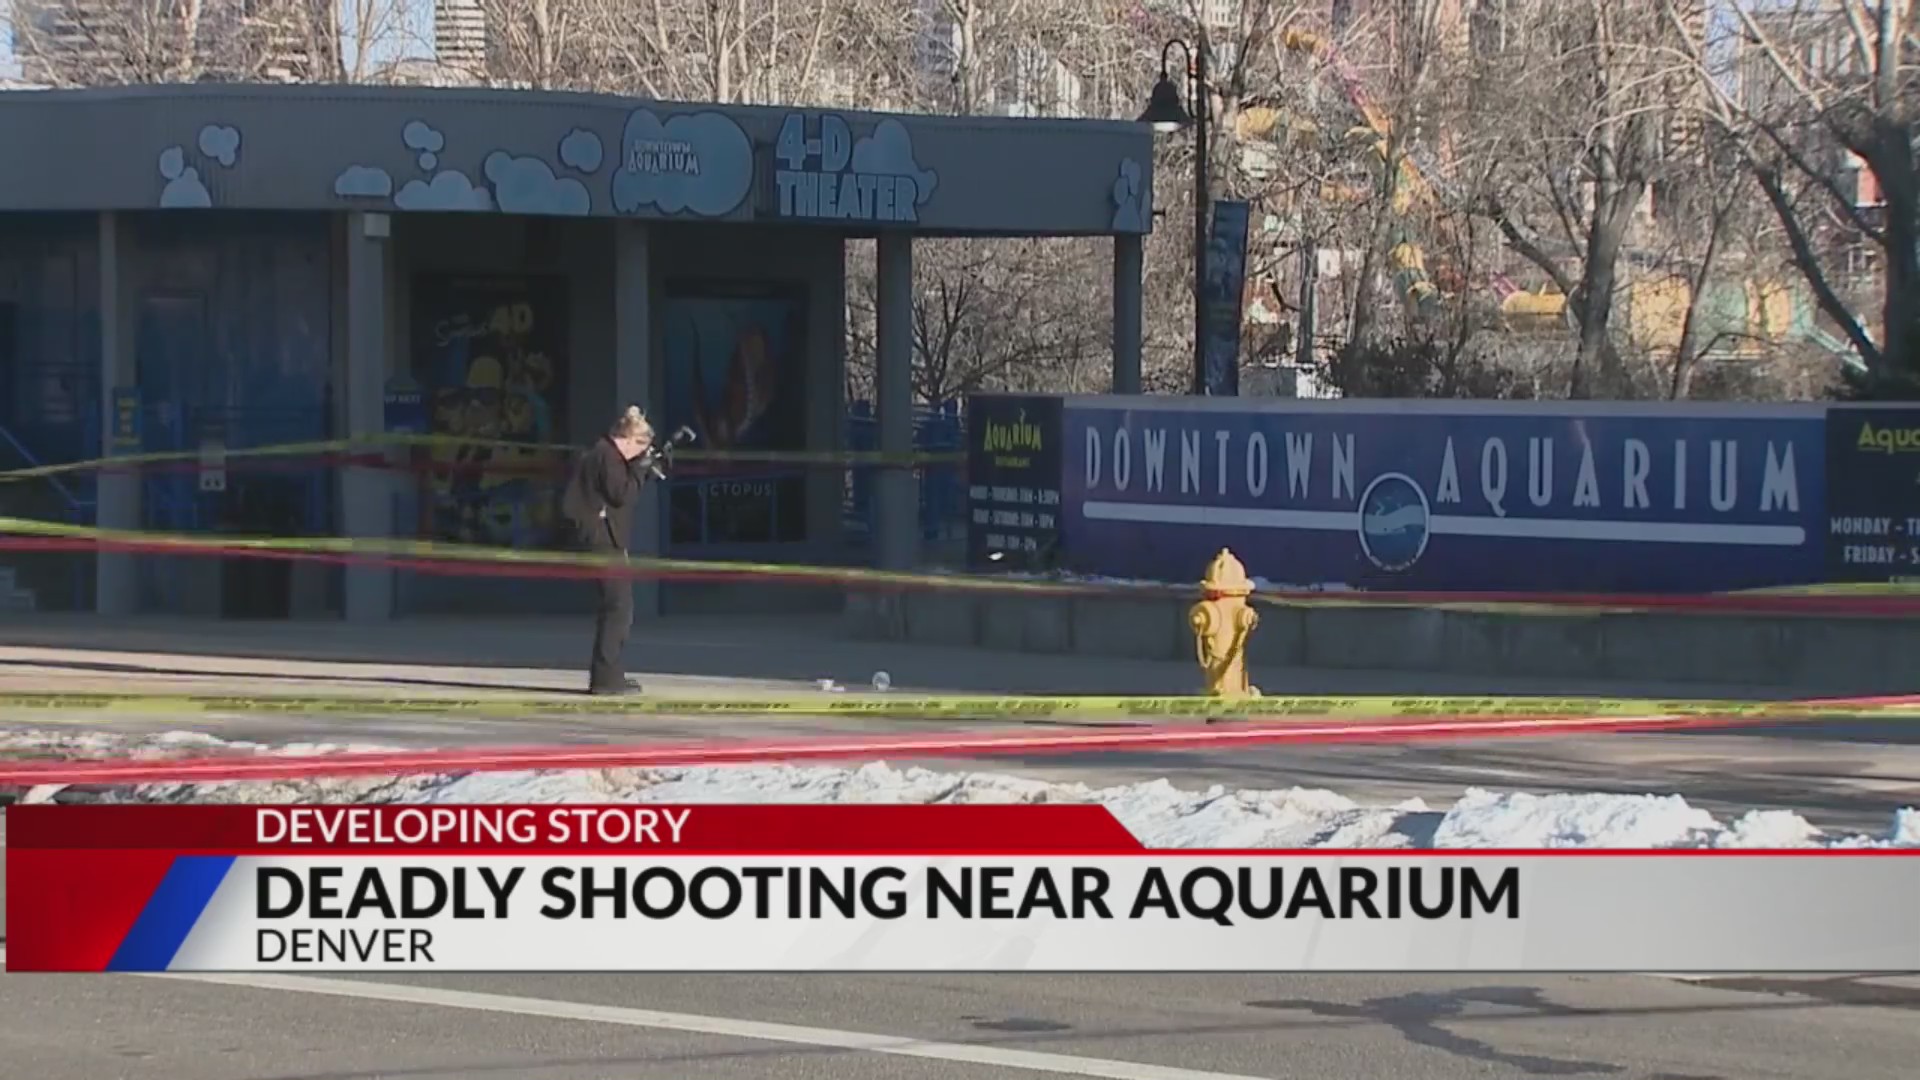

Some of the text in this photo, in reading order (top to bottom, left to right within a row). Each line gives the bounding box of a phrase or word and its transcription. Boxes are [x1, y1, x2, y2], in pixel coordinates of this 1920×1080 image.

[777, 113, 851, 171] 4-D
[628, 150, 700, 175] AQUARIUM
[777, 172, 918, 221] THEATER
[984, 416, 1042, 451] AQUARIUM
[1086, 426, 1800, 516] DOWNTOWN AQUARIUM
[1830, 517, 1891, 535] MONDAY
[1844, 545, 1895, 563] FRIDAY
